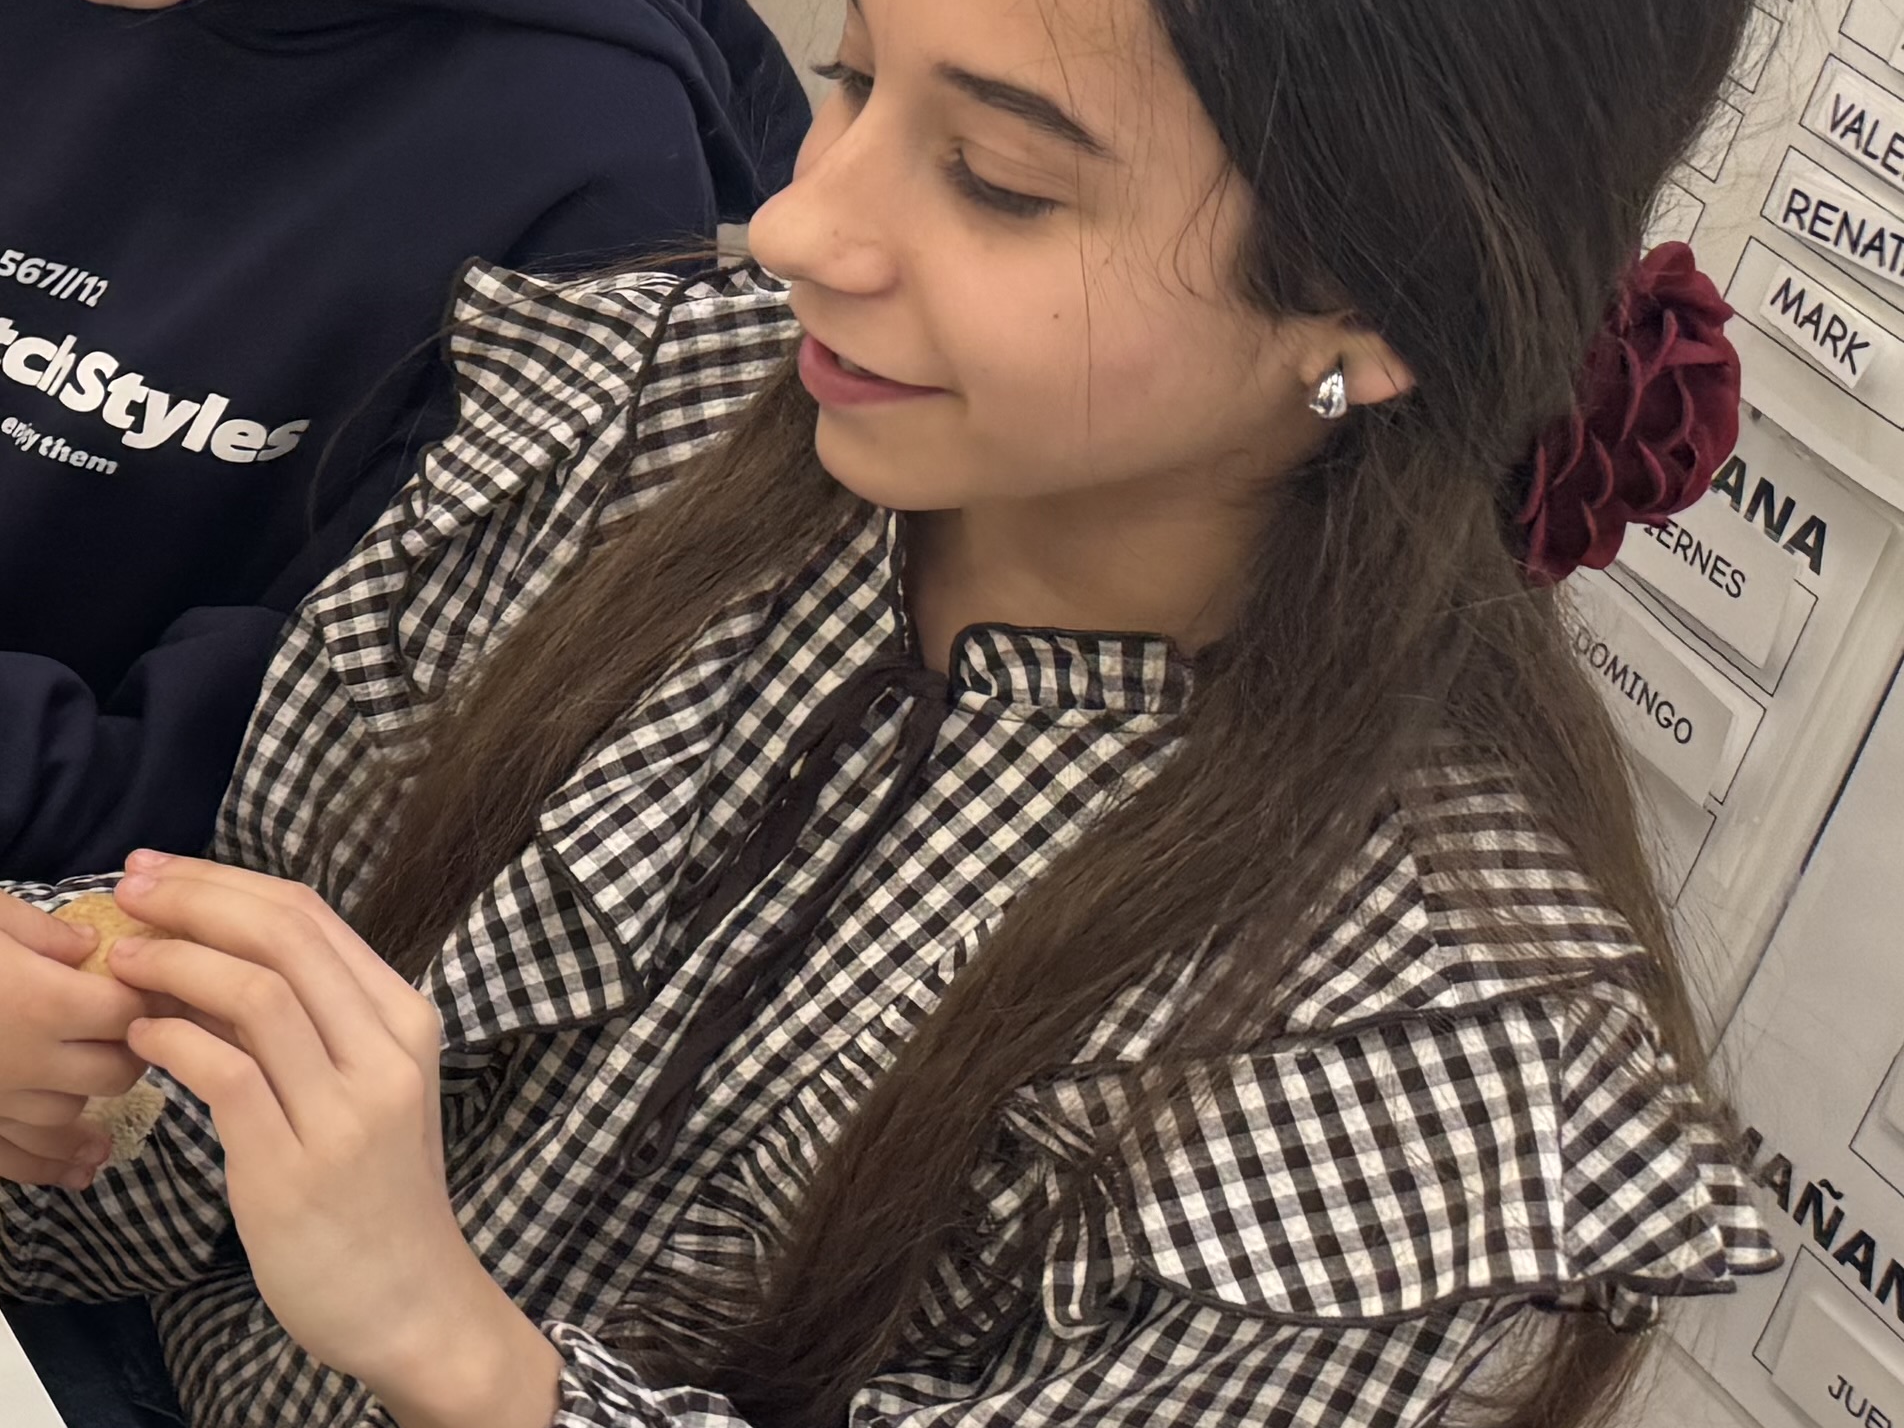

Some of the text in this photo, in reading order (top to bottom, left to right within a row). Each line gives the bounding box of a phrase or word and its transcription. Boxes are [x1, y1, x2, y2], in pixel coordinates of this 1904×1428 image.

[1769, 276, 1873, 376] MARK
[1643, 516, 1746, 599] IERNES
[1711, 454, 1829, 576] ANA
[1572, 628, 1693, 746] DOMINGO
